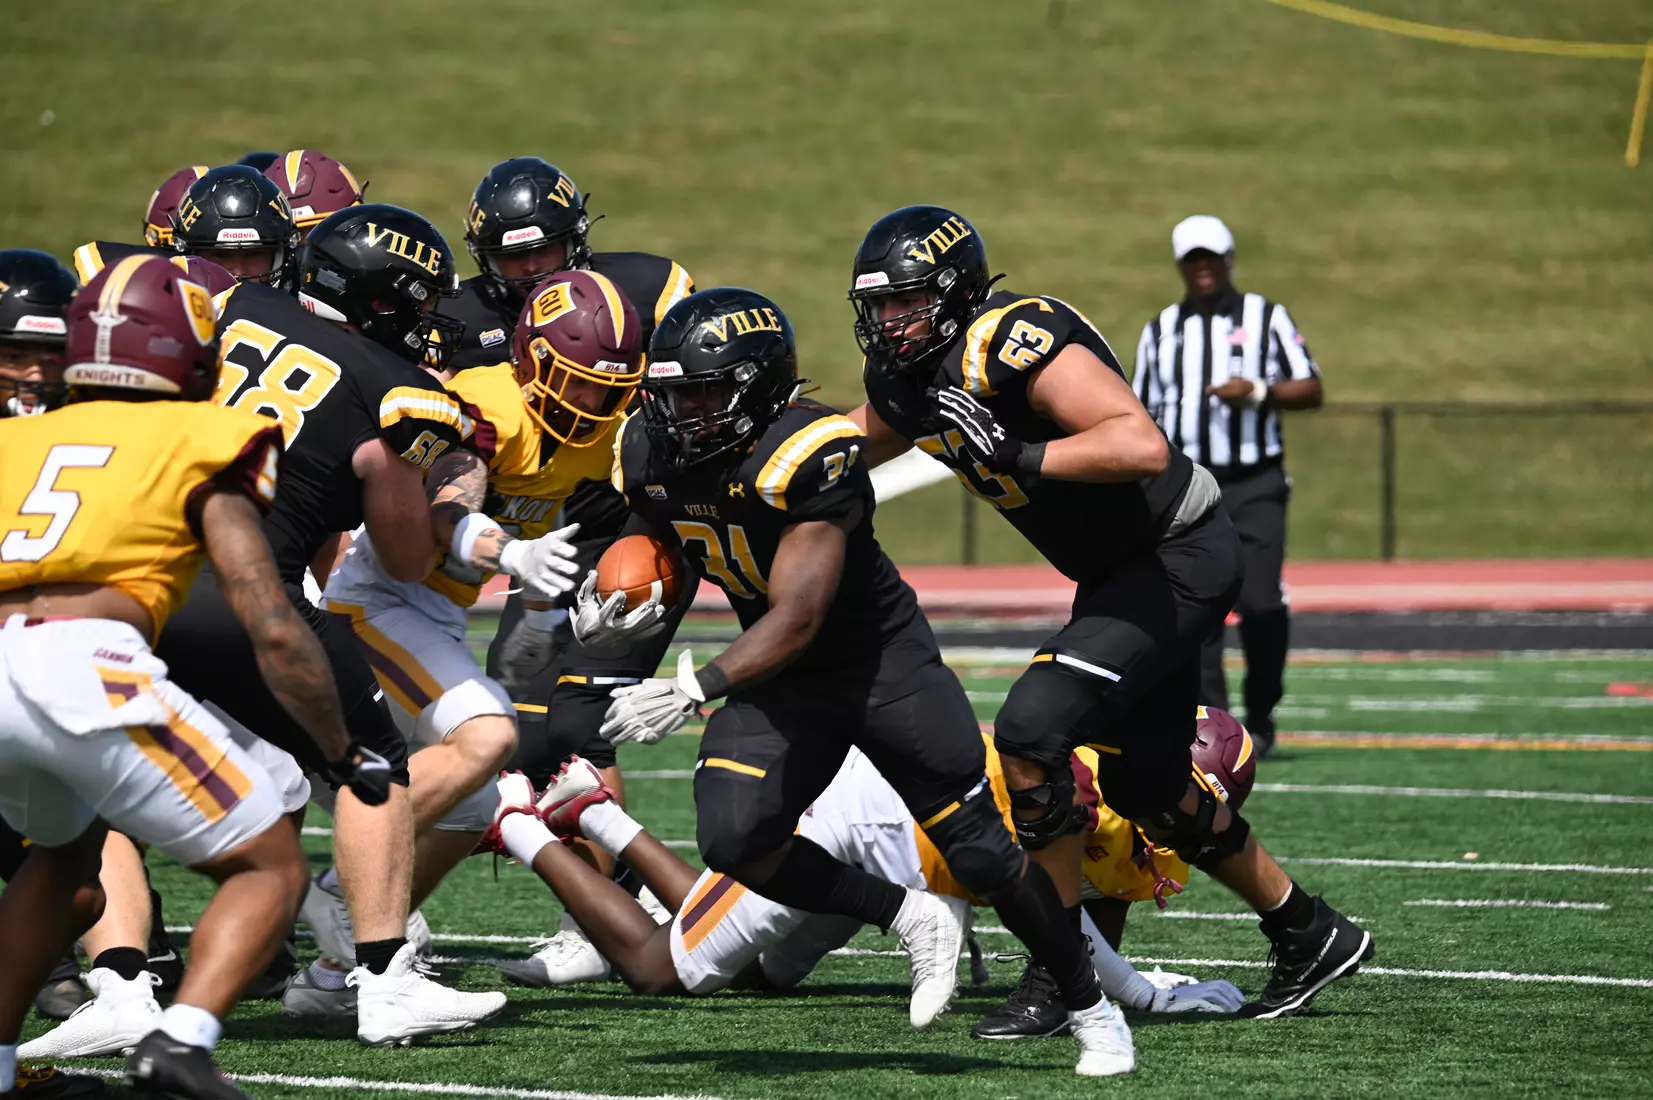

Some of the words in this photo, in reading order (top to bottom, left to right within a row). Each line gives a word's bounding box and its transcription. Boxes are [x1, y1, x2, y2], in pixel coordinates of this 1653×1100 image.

[365, 222, 442, 276] VILLE
[908, 216, 972, 265] VILLE
[539, 289, 563, 317] GU
[704, 307, 783, 343] VILLE
[998, 319, 1055, 371] 63
[75, 368, 146, 386] KNIGHTS
[400, 429, 450, 470] 68
[0, 443, 117, 563] 5
[684, 504, 721, 520] VILLE
[670, 520, 769, 600] 31
